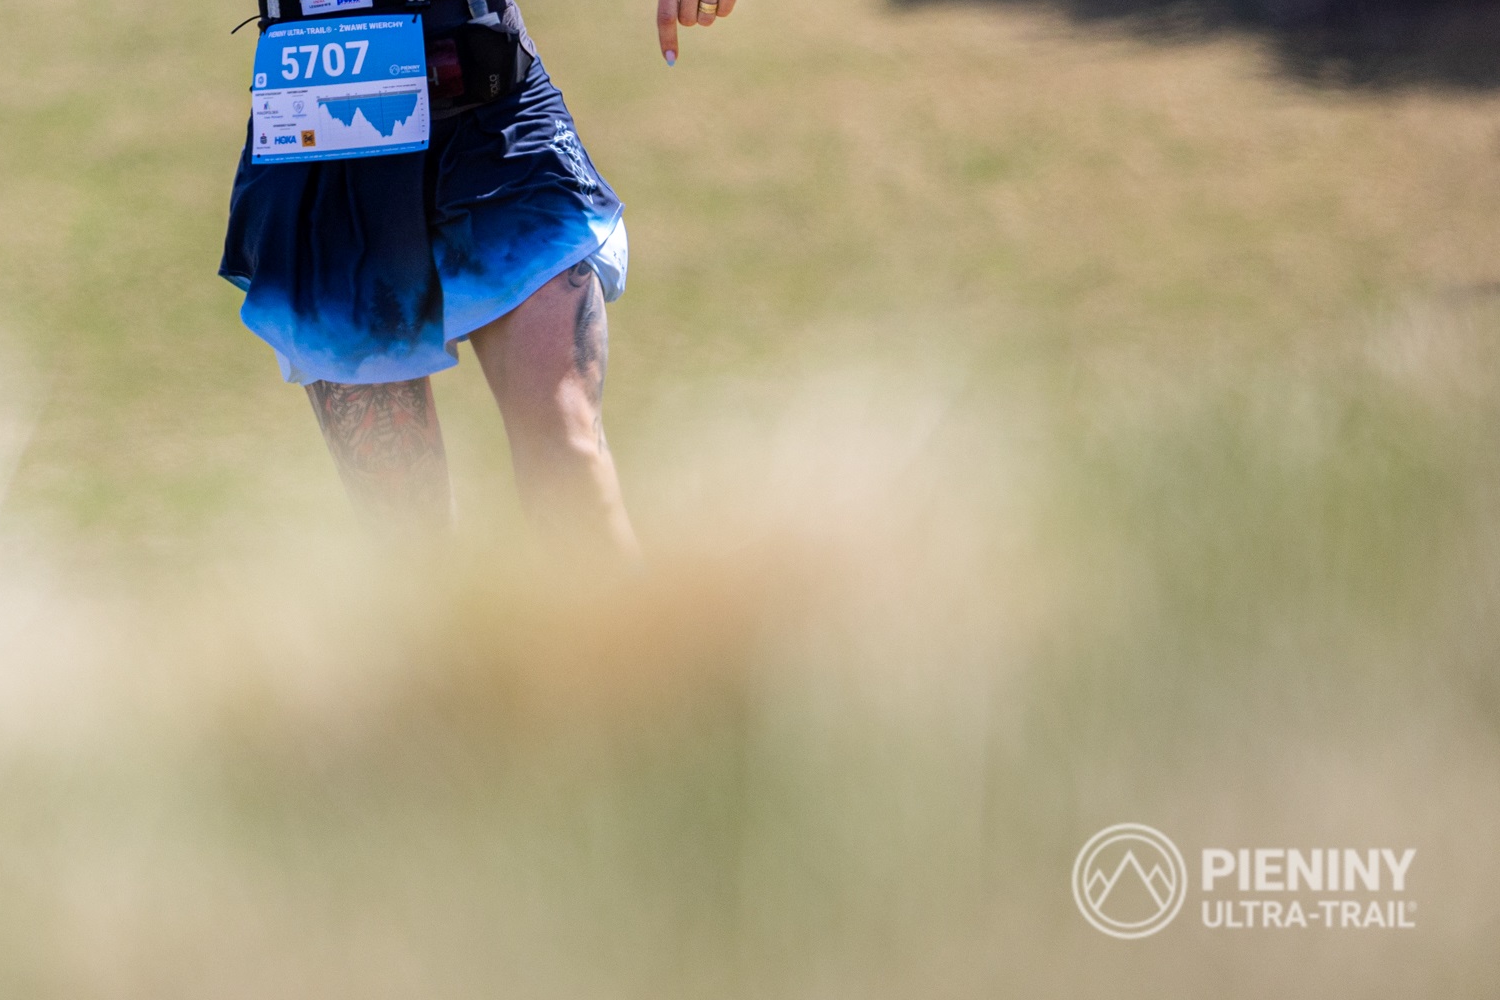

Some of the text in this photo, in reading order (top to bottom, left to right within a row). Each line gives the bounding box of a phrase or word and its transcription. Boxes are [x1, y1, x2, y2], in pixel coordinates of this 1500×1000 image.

[369, 21, 404, 30] WIERCHY
[281, 40, 369, 81] 5707
[274, 135, 297, 145] HOKA
